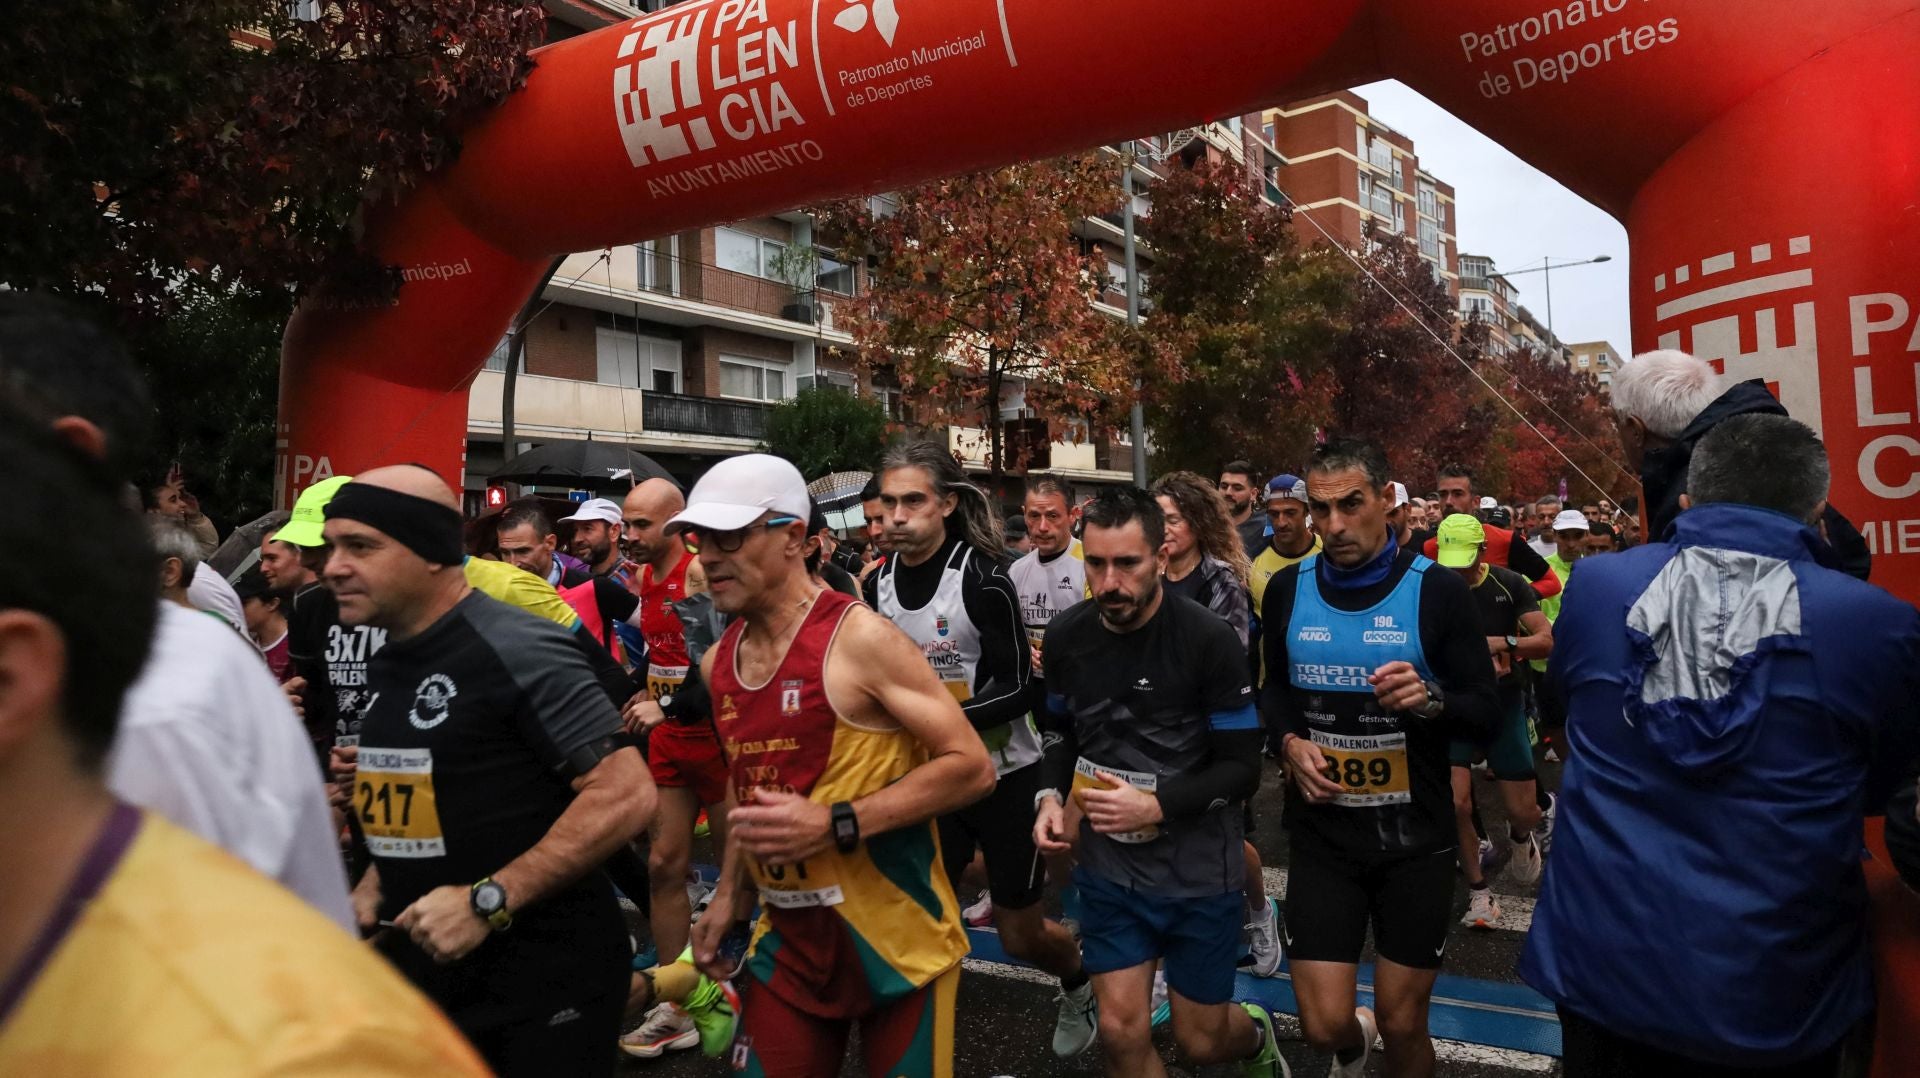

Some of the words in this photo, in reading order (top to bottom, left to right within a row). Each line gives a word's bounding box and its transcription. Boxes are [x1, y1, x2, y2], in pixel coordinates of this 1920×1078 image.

[712, 0, 769, 38] PA
[710, 20, 799, 91] LEN
[838, 51, 911, 87] Patronato
[912, 31, 987, 66] Municipal
[1479, 70, 1511, 99] de
[1513, 17, 1680, 91] Deportes
[718, 81, 806, 141] CIA
[846, 90, 865, 108] de
[865, 73, 933, 106] Deportes
[646, 139, 824, 199] AYUNTAMIENTO
[1854, 362, 1920, 427] L
[1298, 631, 1331, 641] MUNDO
[1333, 738, 1379, 749] PALENCIA
[360, 781, 414, 826] 217
